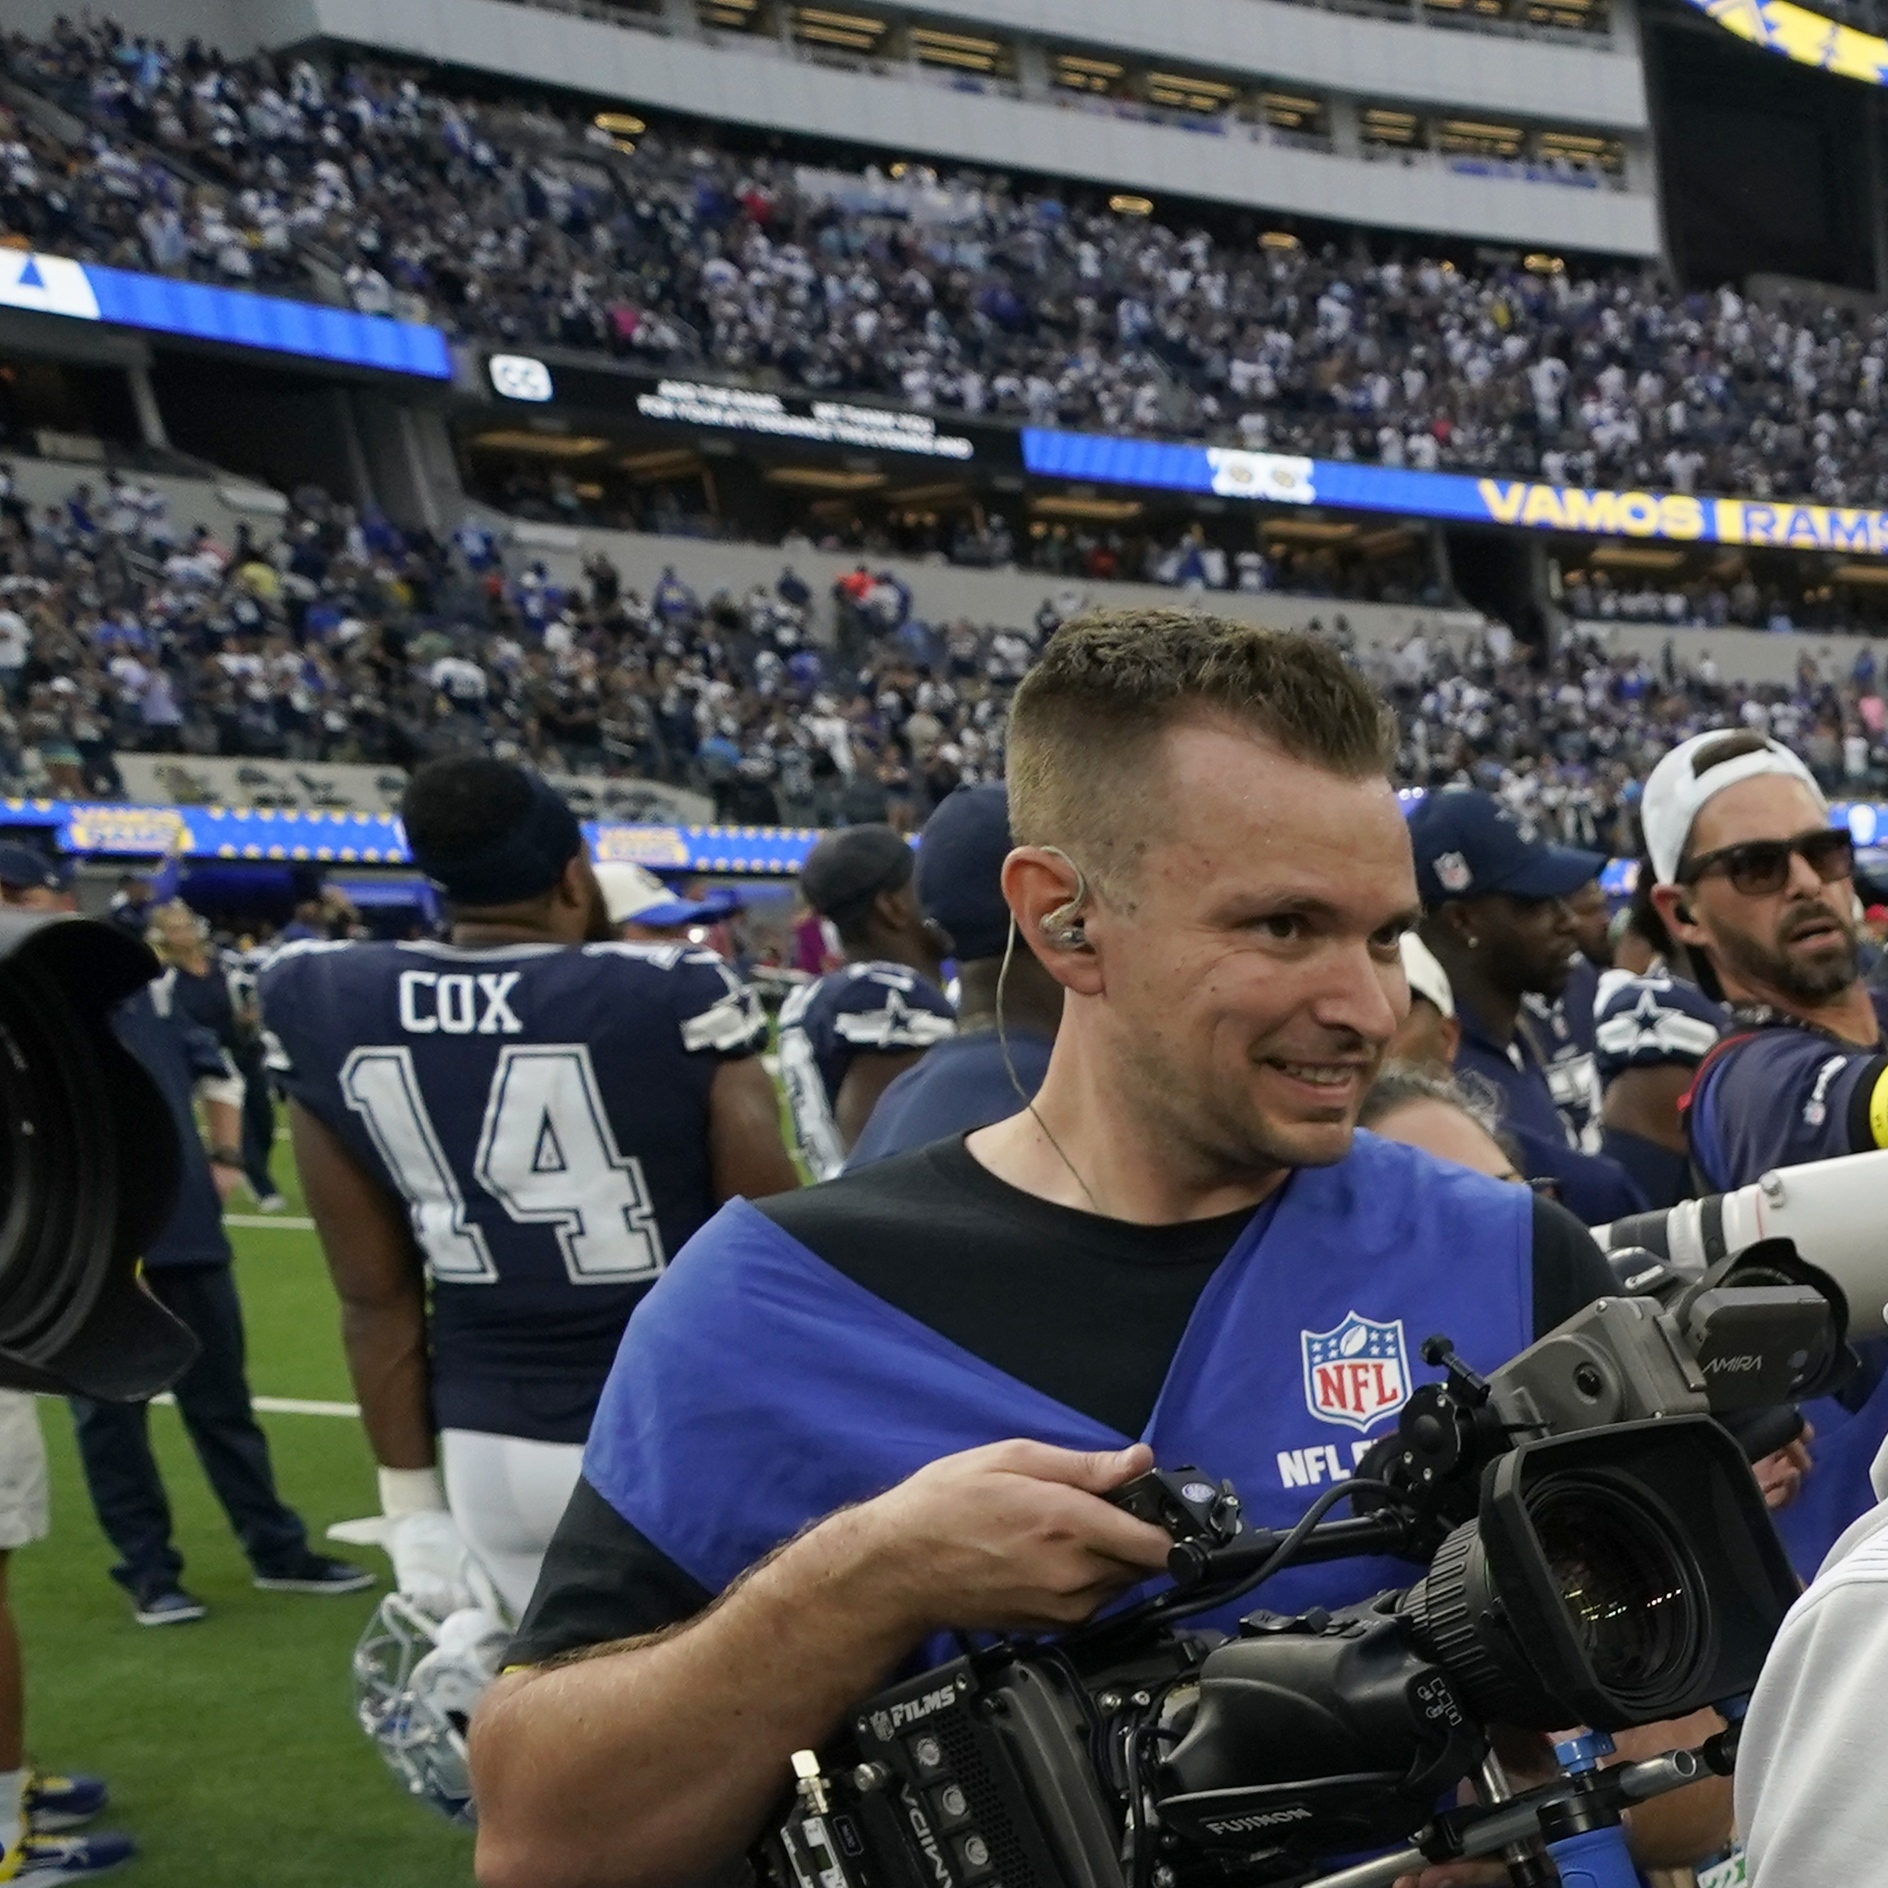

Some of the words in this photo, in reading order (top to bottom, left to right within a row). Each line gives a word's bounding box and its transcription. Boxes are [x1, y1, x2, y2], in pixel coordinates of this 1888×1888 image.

[1480, 480, 1704, 540] VAMOS
[400, 971, 523, 1035] COX
[339, 1043, 667, 1285] 14
[1315, 1363, 1400, 1413] NFL
[1703, 1353, 1763, 1376] AMIRA
[1276, 1444, 1351, 1489] NFL
[889, 1685, 956, 1728] FILMS
[1206, 1803, 1312, 1836] FUJINON
